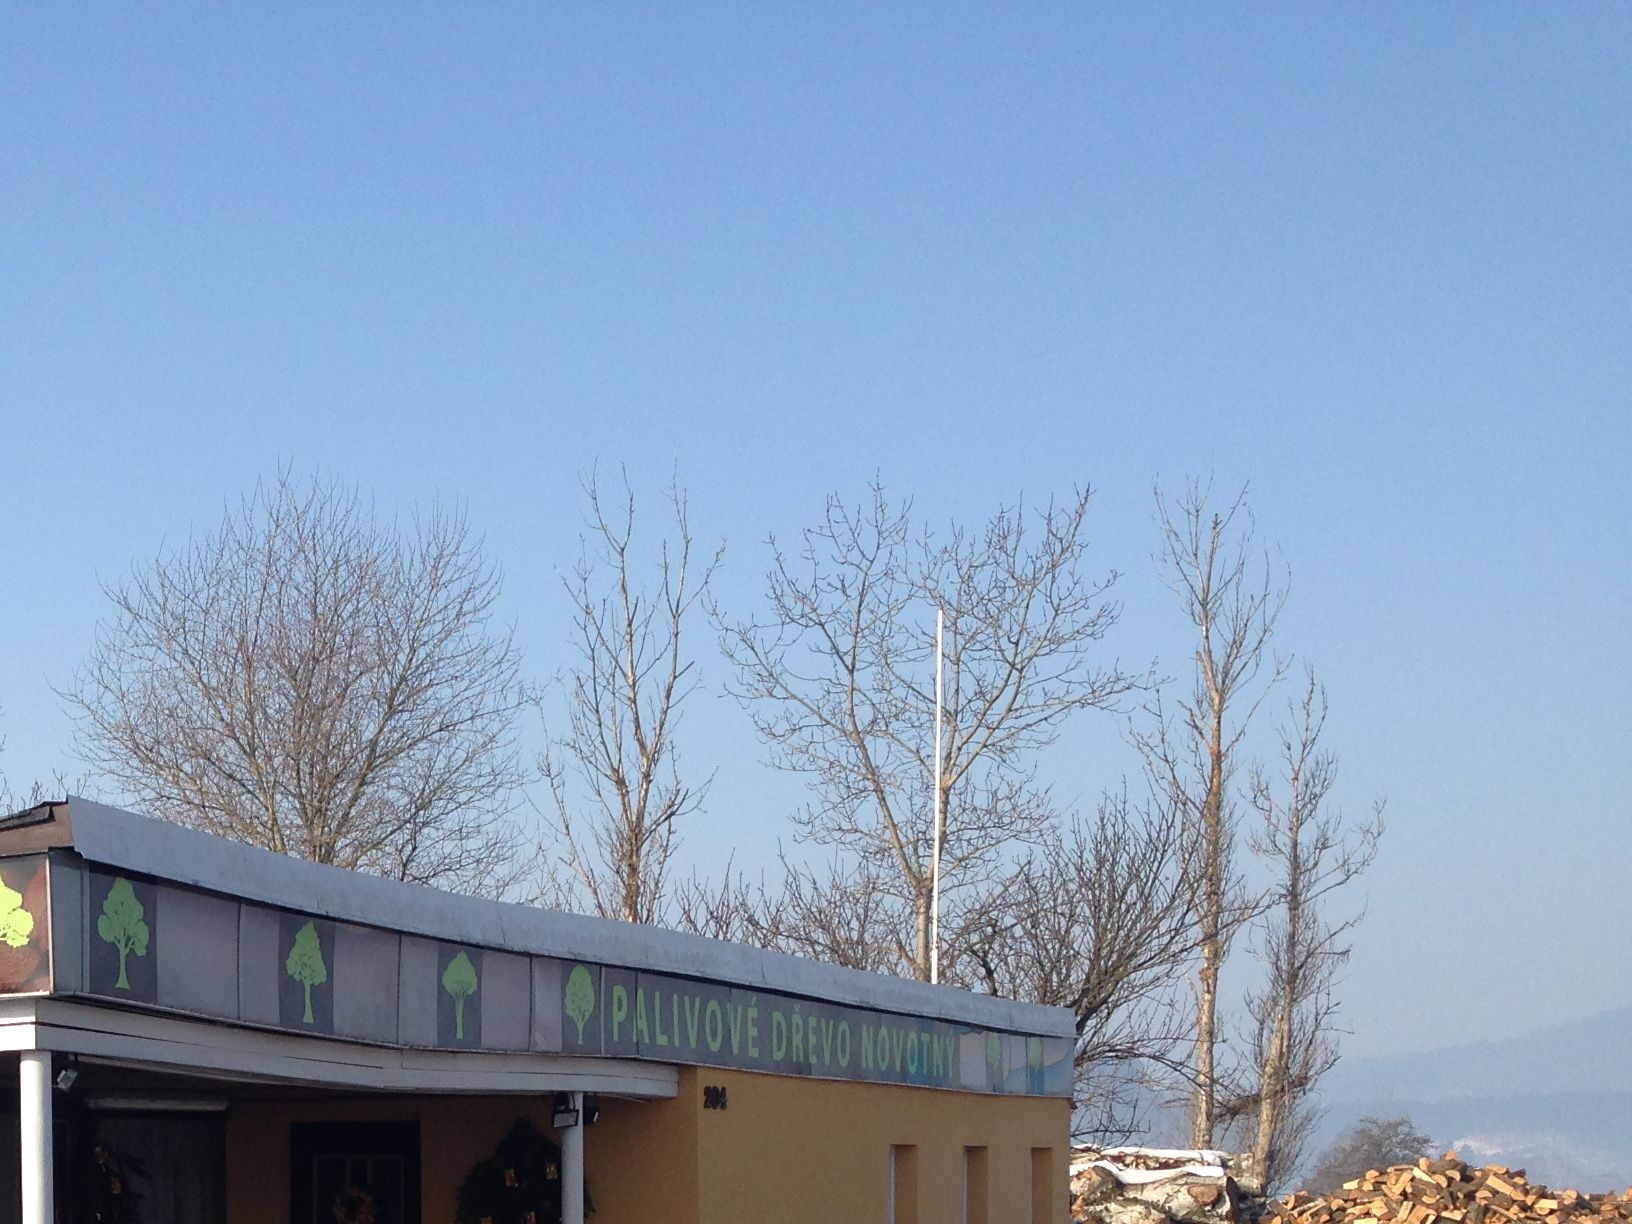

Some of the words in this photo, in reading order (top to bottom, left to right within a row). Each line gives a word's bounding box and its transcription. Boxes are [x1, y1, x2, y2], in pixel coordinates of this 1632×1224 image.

[613, 985, 759, 1058] PALIVOVÉ
[772, 1004, 851, 1068] DŘEVO
[862, 1028, 955, 1078] NOVOTNÝ
